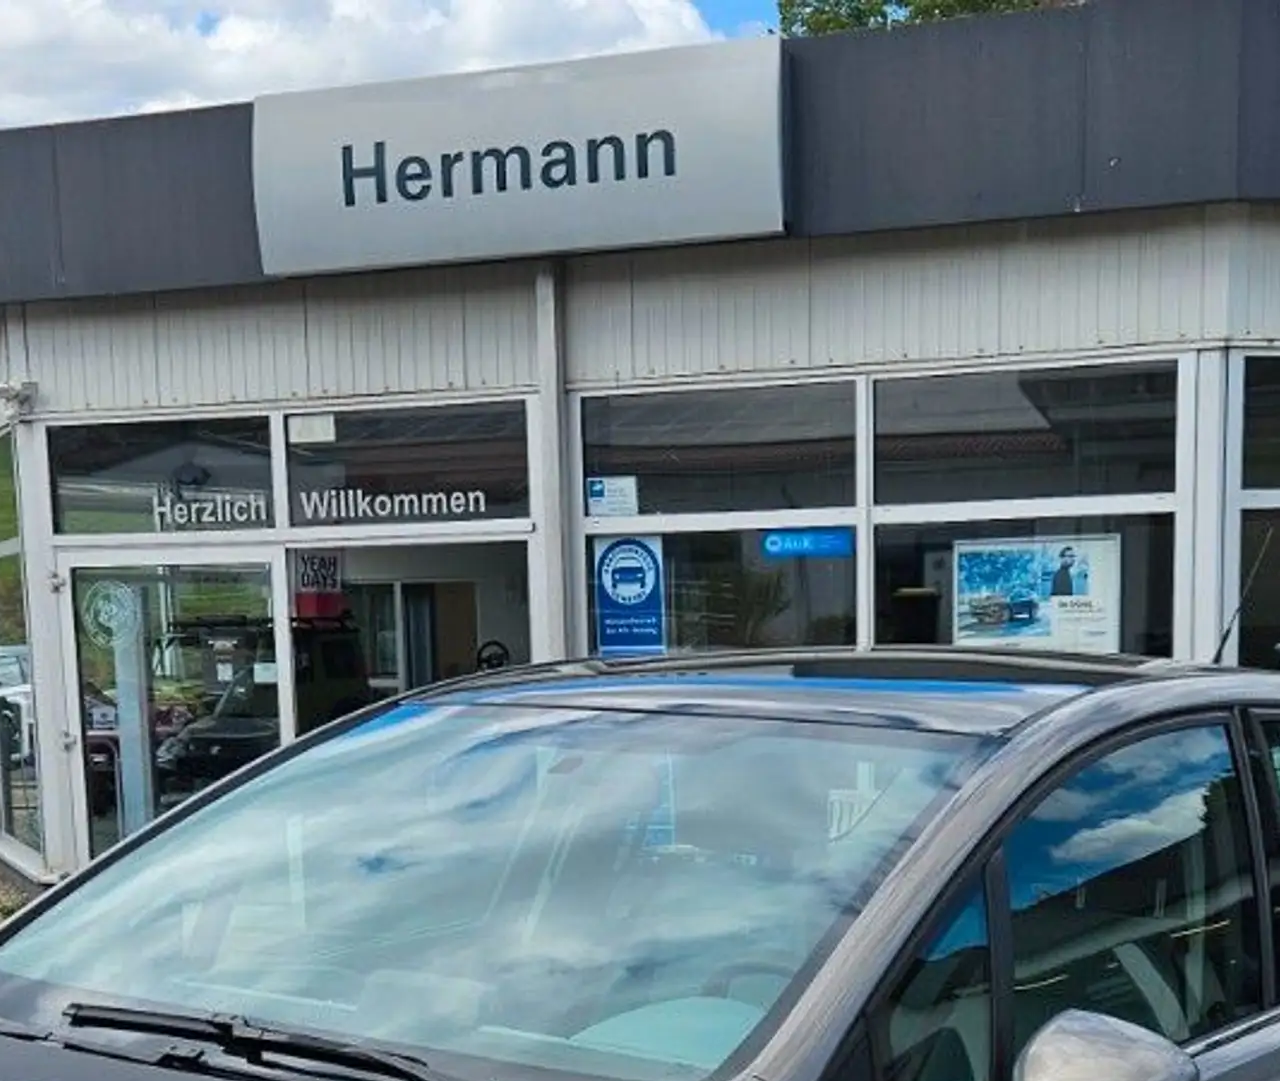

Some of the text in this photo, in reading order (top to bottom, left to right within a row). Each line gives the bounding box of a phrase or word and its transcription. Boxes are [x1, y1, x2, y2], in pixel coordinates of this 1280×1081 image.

[341, 129, 676, 207] Hermann
[153, 488, 486, 525] Herzlich Willkommen
[300, 555, 337, 573] YEAH
[300, 573, 337, 589] DAYS
